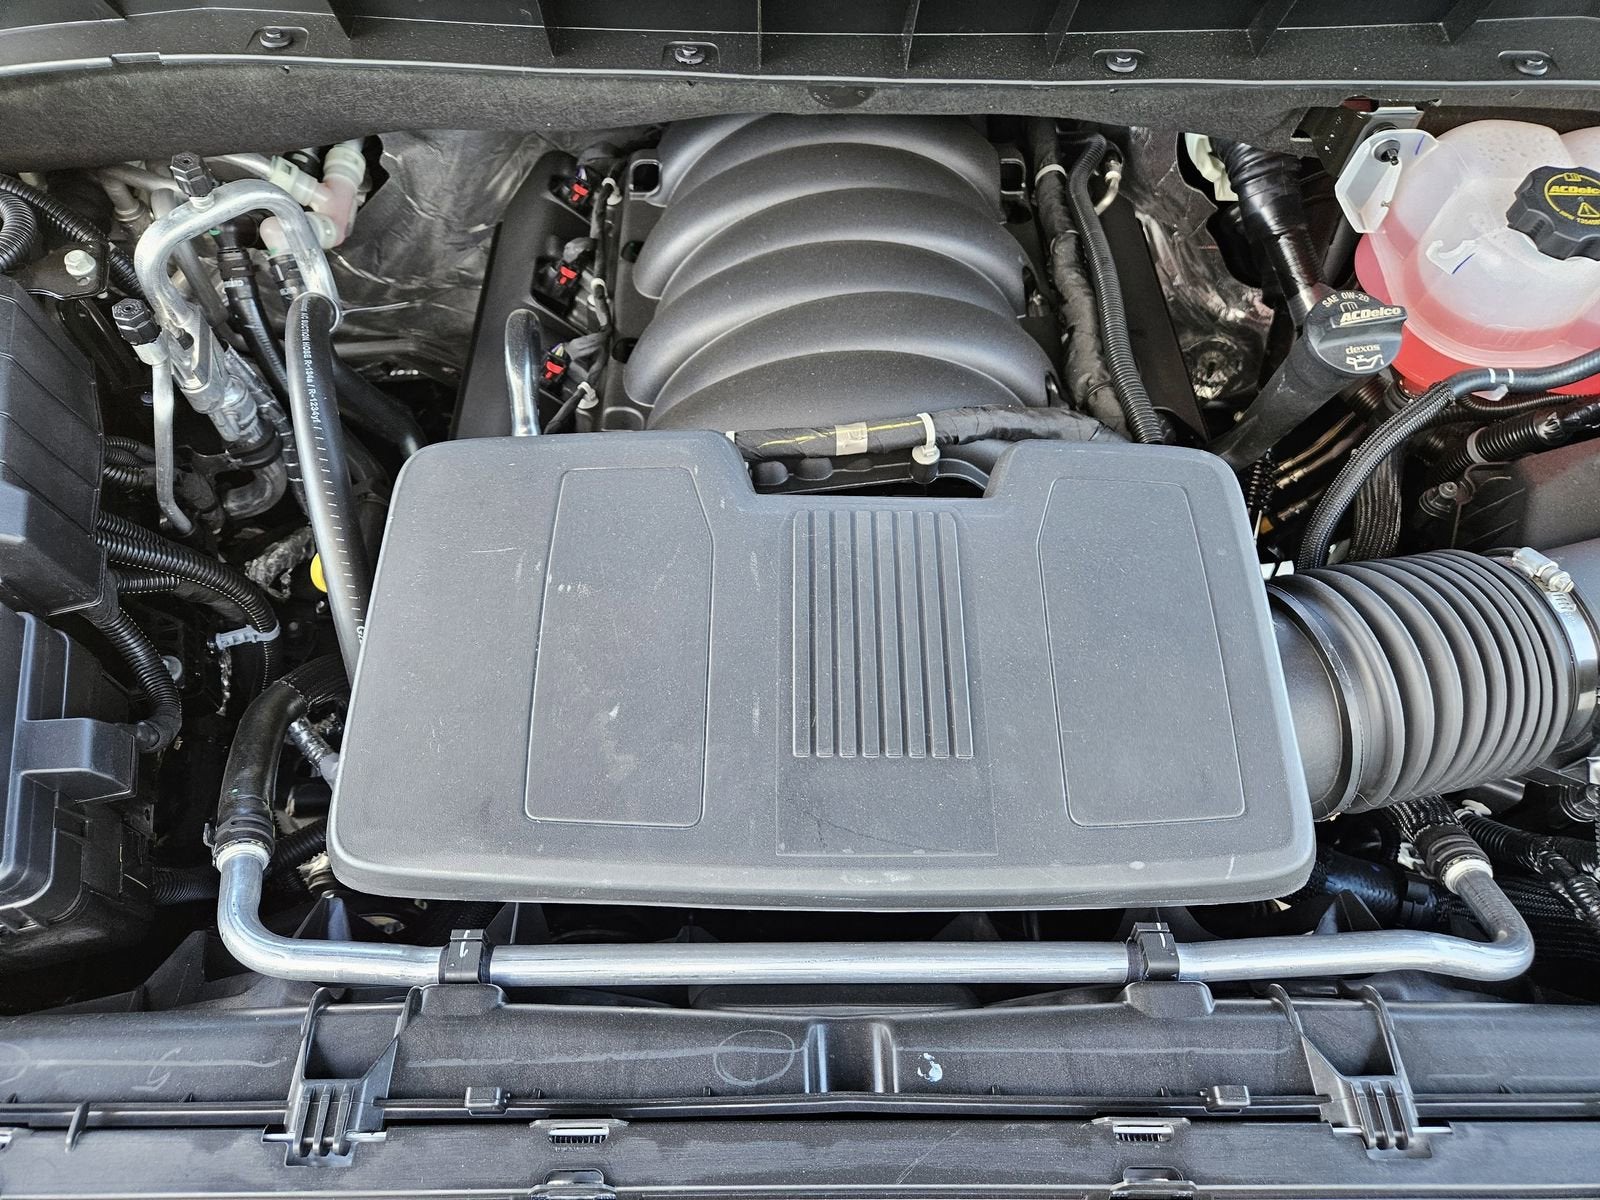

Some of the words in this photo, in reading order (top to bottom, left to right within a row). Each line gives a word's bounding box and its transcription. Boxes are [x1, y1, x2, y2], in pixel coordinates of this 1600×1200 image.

[1322, 294, 1339, 308] SAE
[1341, 291, 1370, 303] 0W-20
[1340, 307, 1401, 322] ACDelco
[302, 341, 312, 359] HOSE
[1345, 344, 1381, 354] dexos
